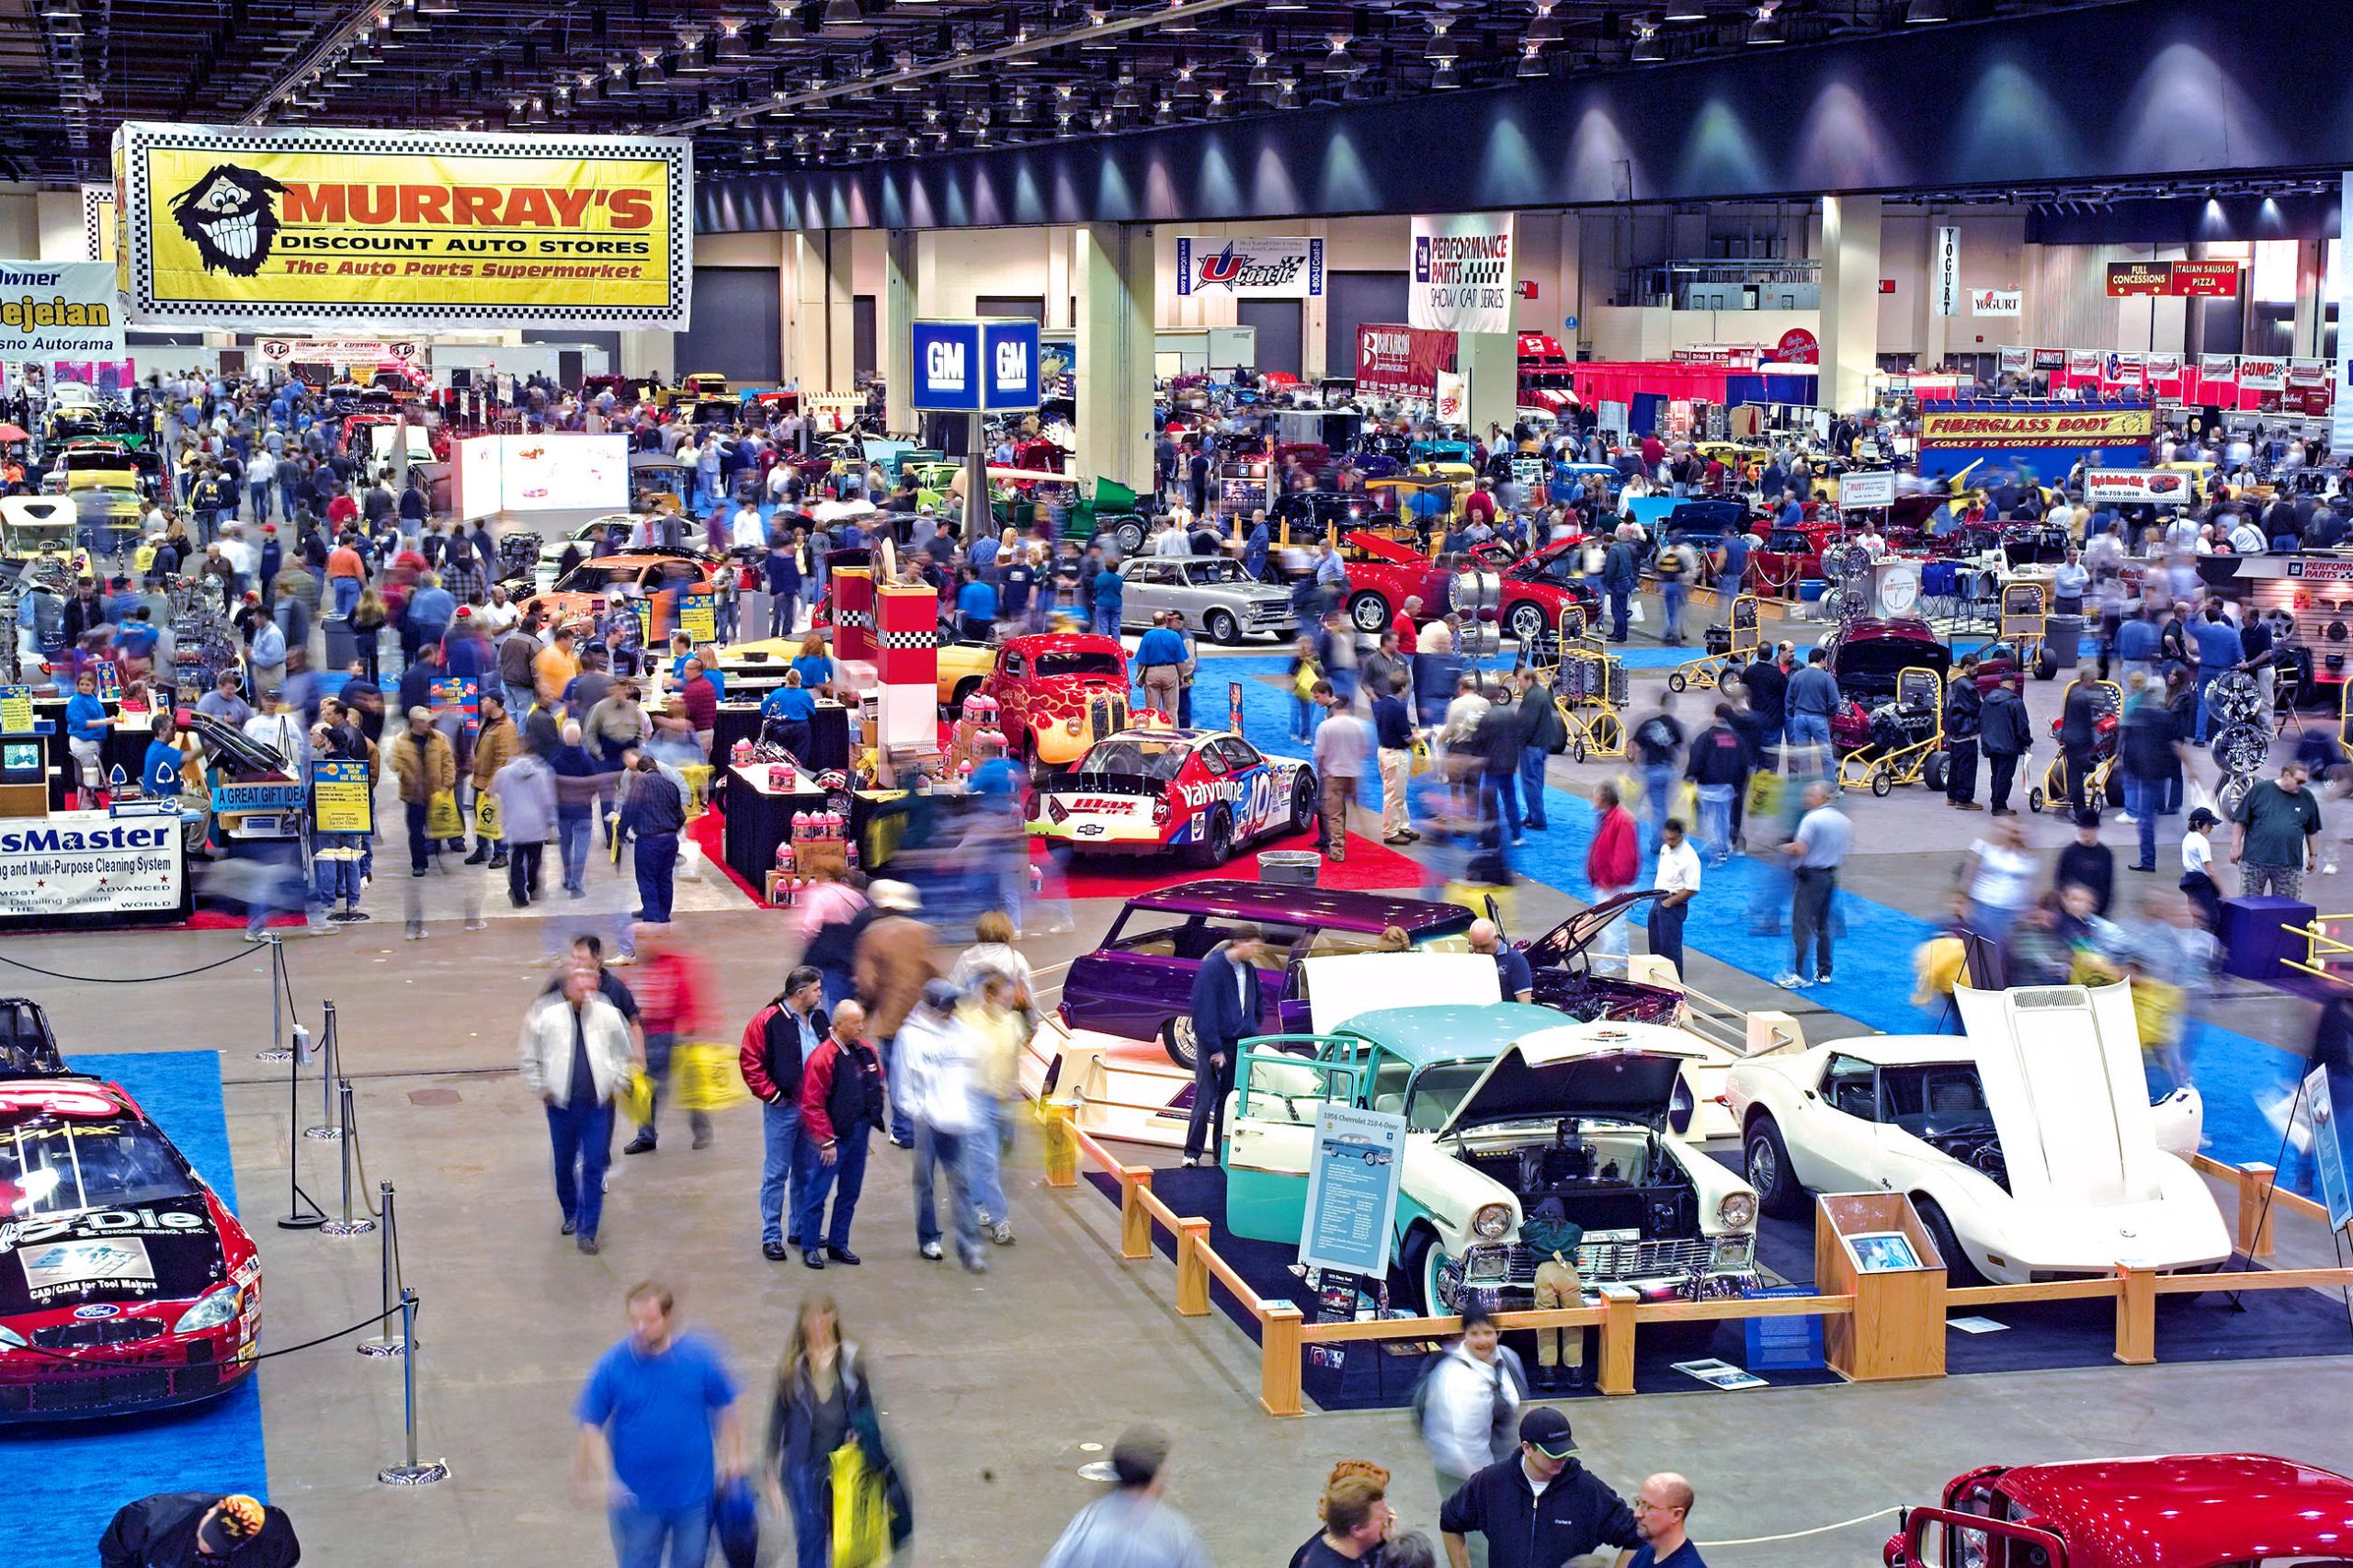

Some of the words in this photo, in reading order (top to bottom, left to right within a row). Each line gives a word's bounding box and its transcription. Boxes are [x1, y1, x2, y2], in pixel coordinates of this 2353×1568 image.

[282, 184, 654, 229] MURRAY'S
[280, 236, 434, 251] DISCOUNT
[446, 238, 528, 253] AUTO
[540, 239, 650, 255] STORES
[1431, 234, 1508, 260] PERFORMANCE
[0, 269, 61, 286] wner
[285, 259, 329, 276] The
[336, 260, 396, 276] Auto
[404, 261, 474, 278] Parts
[481, 263, 642, 279] Supermarket
[1431, 261, 1462, 285] PARTS
[1943, 228, 1954, 316] YOGURT
[2131, 265, 2148, 275] FULL
[2176, 265, 2203, 274] ITALIAN
[2204, 265, 2235, 274] SAUSAGE
[2112, 274, 2166, 285] CONCESSIONS
[2192, 278, 2216, 287] PIZZA
[1430, 288, 1458, 308] SHOW
[1460, 288, 1478, 309] CAR
[1480, 288, 1505, 309] SERIES
[1975, 299, 2018, 310] YOGURT
[0, 295, 110, 334] ejeian
[32, 337, 114, 351] Autorama
[927, 341, 965, 380] GM
[996, 341, 1027, 380] GM
[2243, 361, 2275, 377] COMP
[1930, 418, 2052, 434] FIBERGLASS
[2056, 417, 2114, 433] BODY
[1931, 439, 1977, 448] COAST
[2003, 438, 2049, 448] COAST
[2051, 438, 2103, 447] STREET
[2108, 437, 2138, 447] ROD
[2290, 564, 2301, 573] GM
[2304, 570, 2337, 579] PARTS
[219, 789, 225, 804] A
[227, 787, 258, 803] GREAT
[261, 787, 282, 802] GIFT
[284, 786, 306, 802] IDEA
[1246, 770, 1272, 833] 10
[11, 860, 28, 876] and
[29, 859, 93, 877] Multi-Purpose
[96, 858, 135, 874] Cleaning
[137, 856, 171, 872] System
[97, 885, 171, 893] ADVANCED
[10, 897, 63, 905] Detailing
[66, 895, 111, 905] System
[1324, 1112, 1338, 1120] 1956
[1338, 1113, 1367, 1126] Chevrolet
[1378, 1120, 1399, 1131] 4-Door
[85, 1209, 203, 1230] Die
[101, 1228, 182, 1236] ENGINEERING,
[29, 1284, 82, 1301] CAD/CAM
[81, 1281, 97, 1292] for
[98, 1278, 119, 1289] Tool
[120, 1278, 158, 1290] Makers
[83, 1305, 110, 1315] Ford
